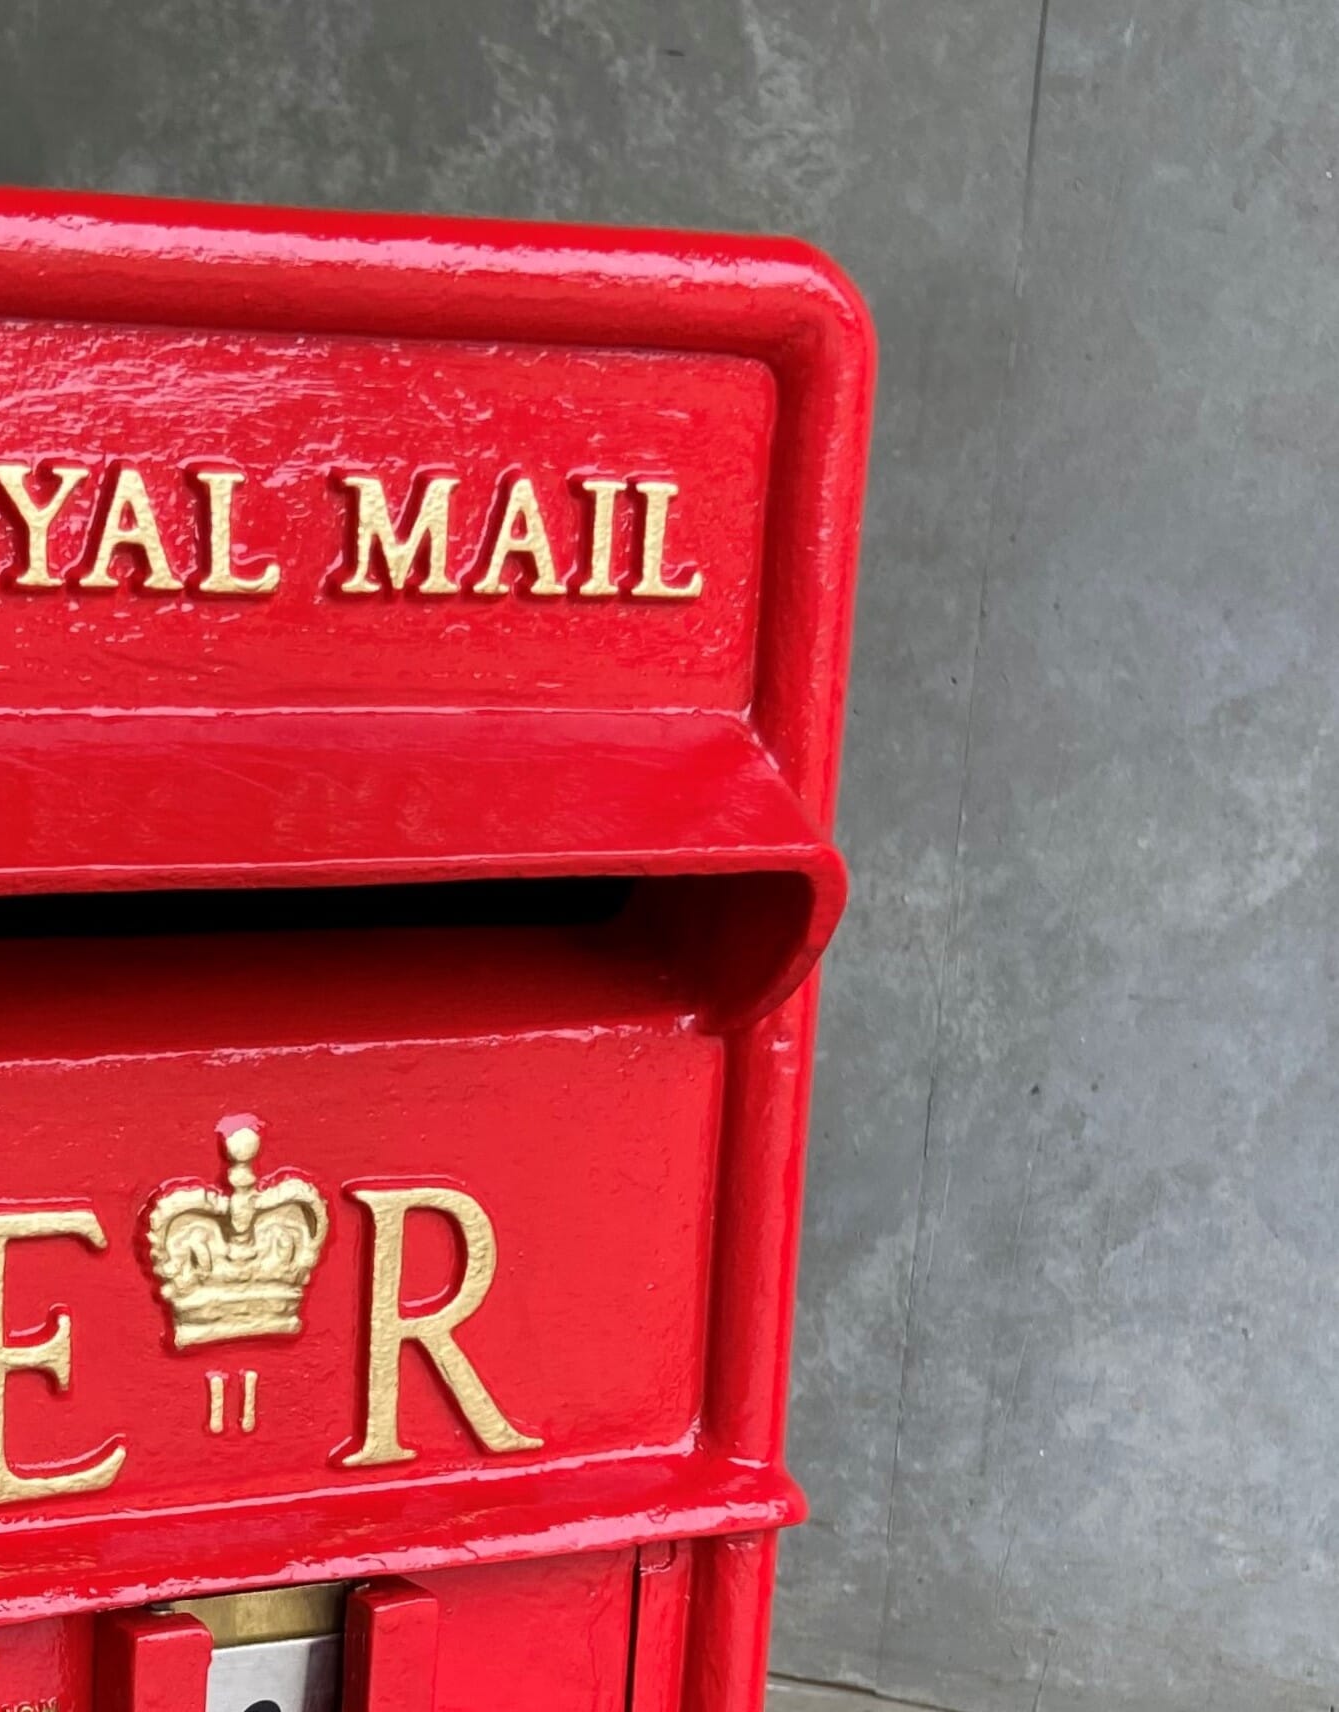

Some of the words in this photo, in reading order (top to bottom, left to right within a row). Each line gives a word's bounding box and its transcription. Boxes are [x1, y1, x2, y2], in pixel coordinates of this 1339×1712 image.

[341, 475, 703, 600] MAIL
[341, 1186, 545, 1467] R
[208, 1369, 259, 1435] II
